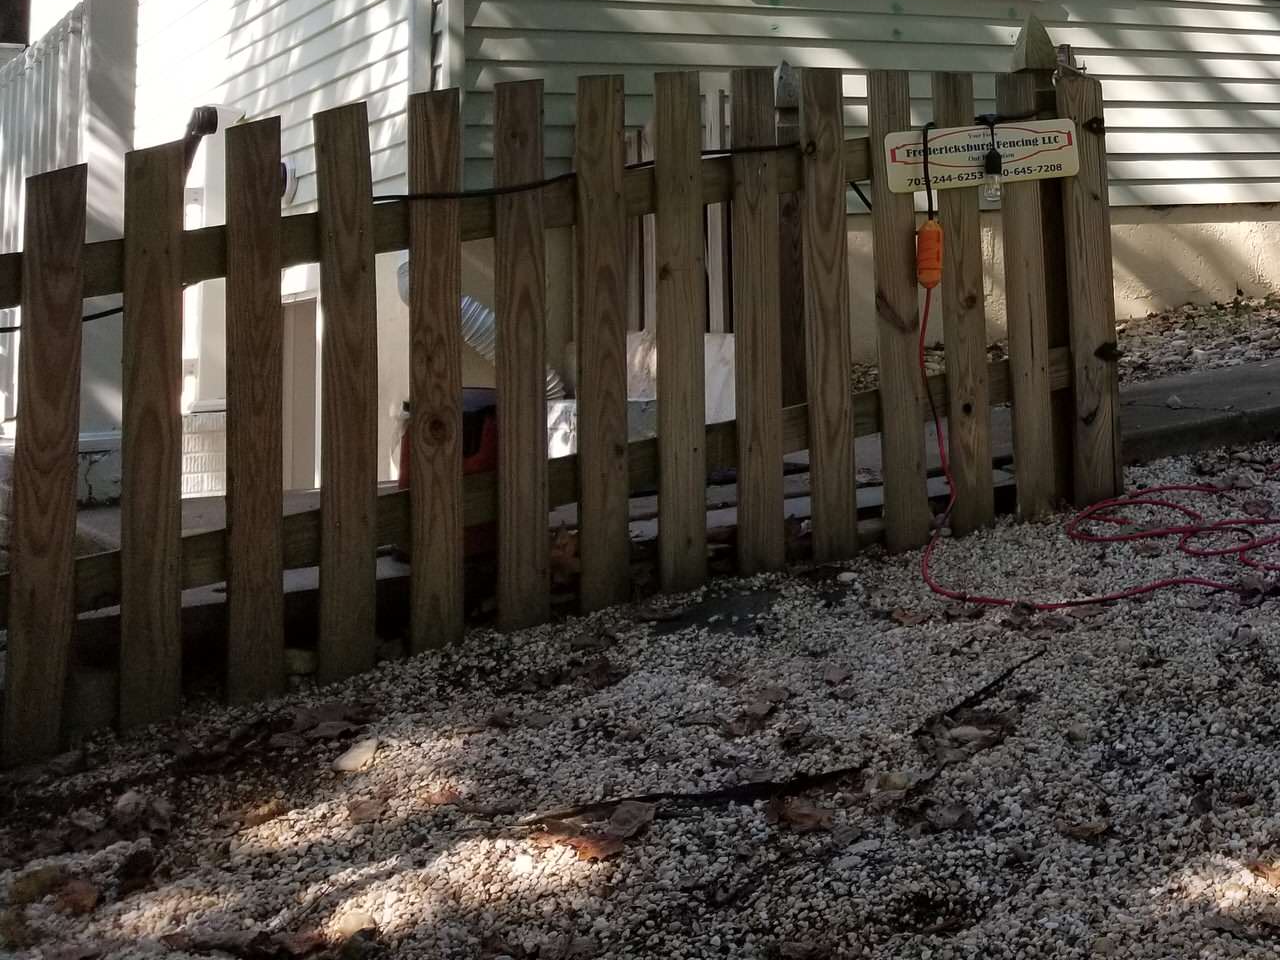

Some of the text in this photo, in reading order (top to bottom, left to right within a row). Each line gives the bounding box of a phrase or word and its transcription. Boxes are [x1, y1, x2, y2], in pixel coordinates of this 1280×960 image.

[996, 137, 1039, 149] Fencing
[1041, 135, 1059, 145] LLC
[1001, 164, 1062, 177] 0-645-7208
